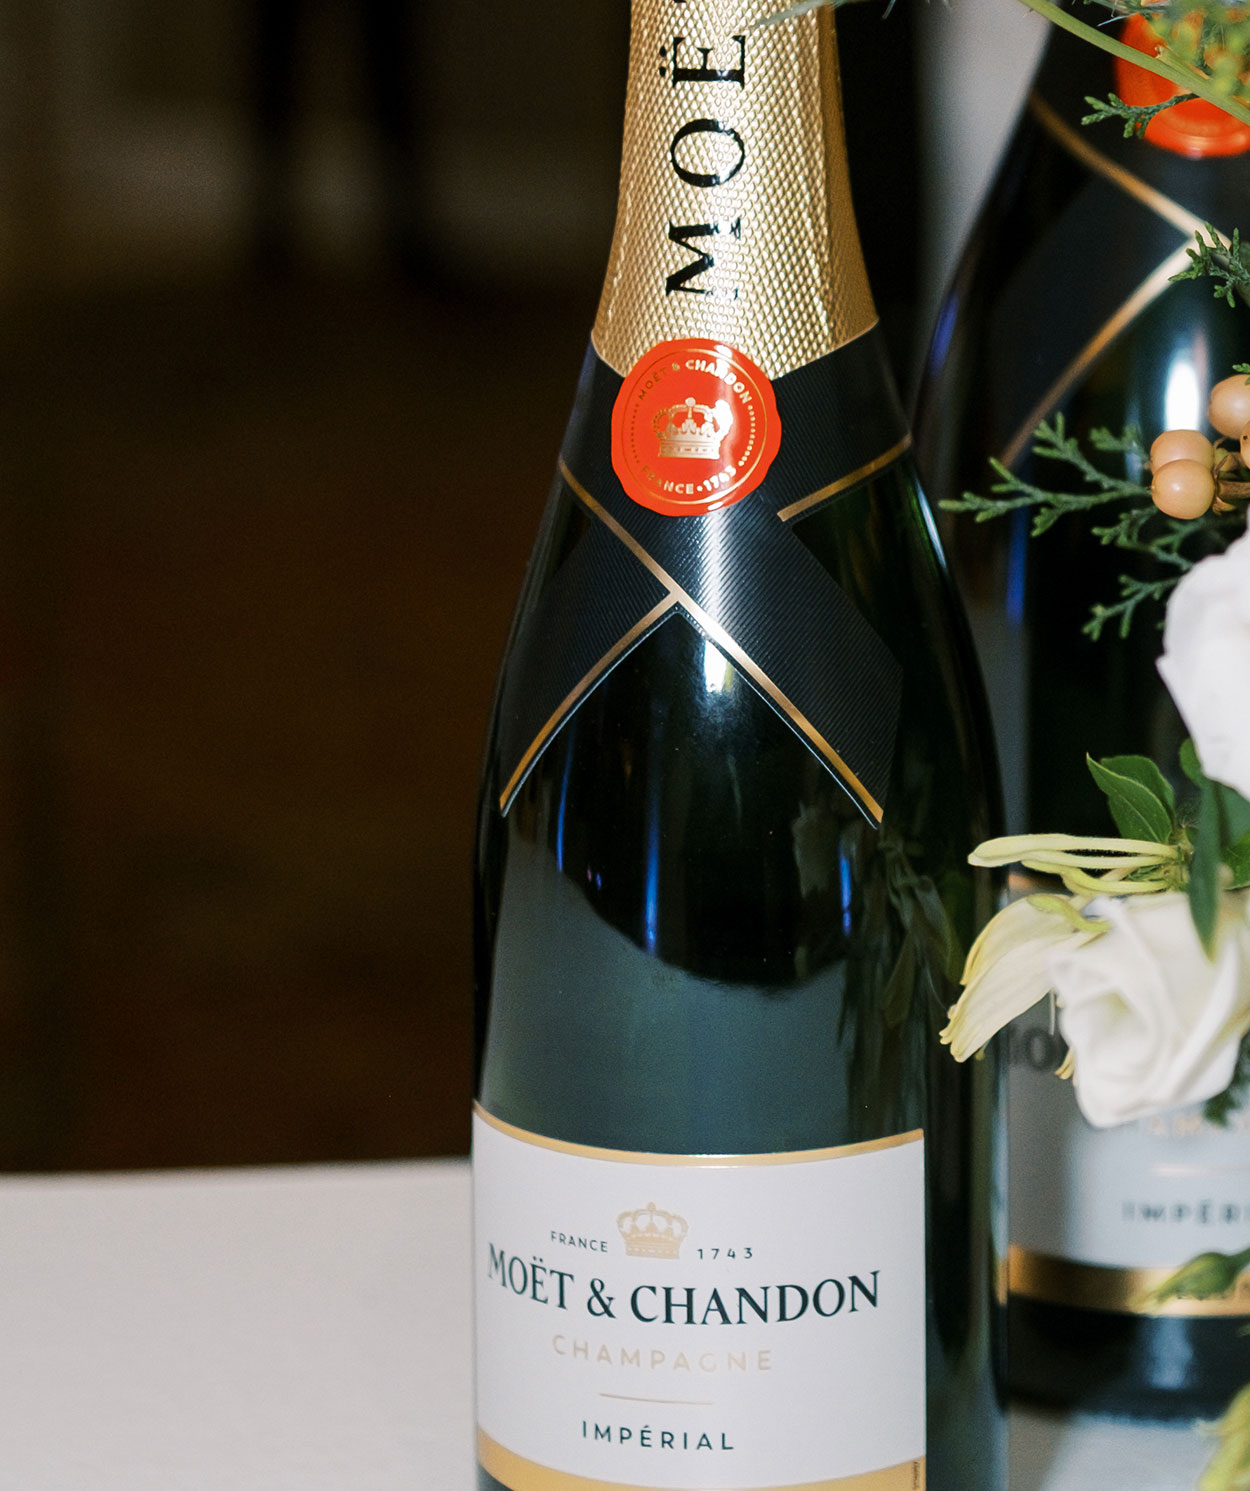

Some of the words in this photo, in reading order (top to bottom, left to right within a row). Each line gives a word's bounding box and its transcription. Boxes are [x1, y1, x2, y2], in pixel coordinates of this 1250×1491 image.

[659, 0, 746, 300] MOË
[685, 359, 753, 404] CHANDON
[642, 465, 694, 495] FRANCE
[550, 1230, 609, 1253] FRANCE
[697, 1247, 753, 1260] 1743
[487, 1243, 575, 1310] MOËT
[586, 1277, 616, 1319] &
[630, 1270, 881, 1325] CHANDON
[552, 1334, 773, 1372] CHAMPAGNE
[582, 1420, 735, 1450] IMPÉRIAL
